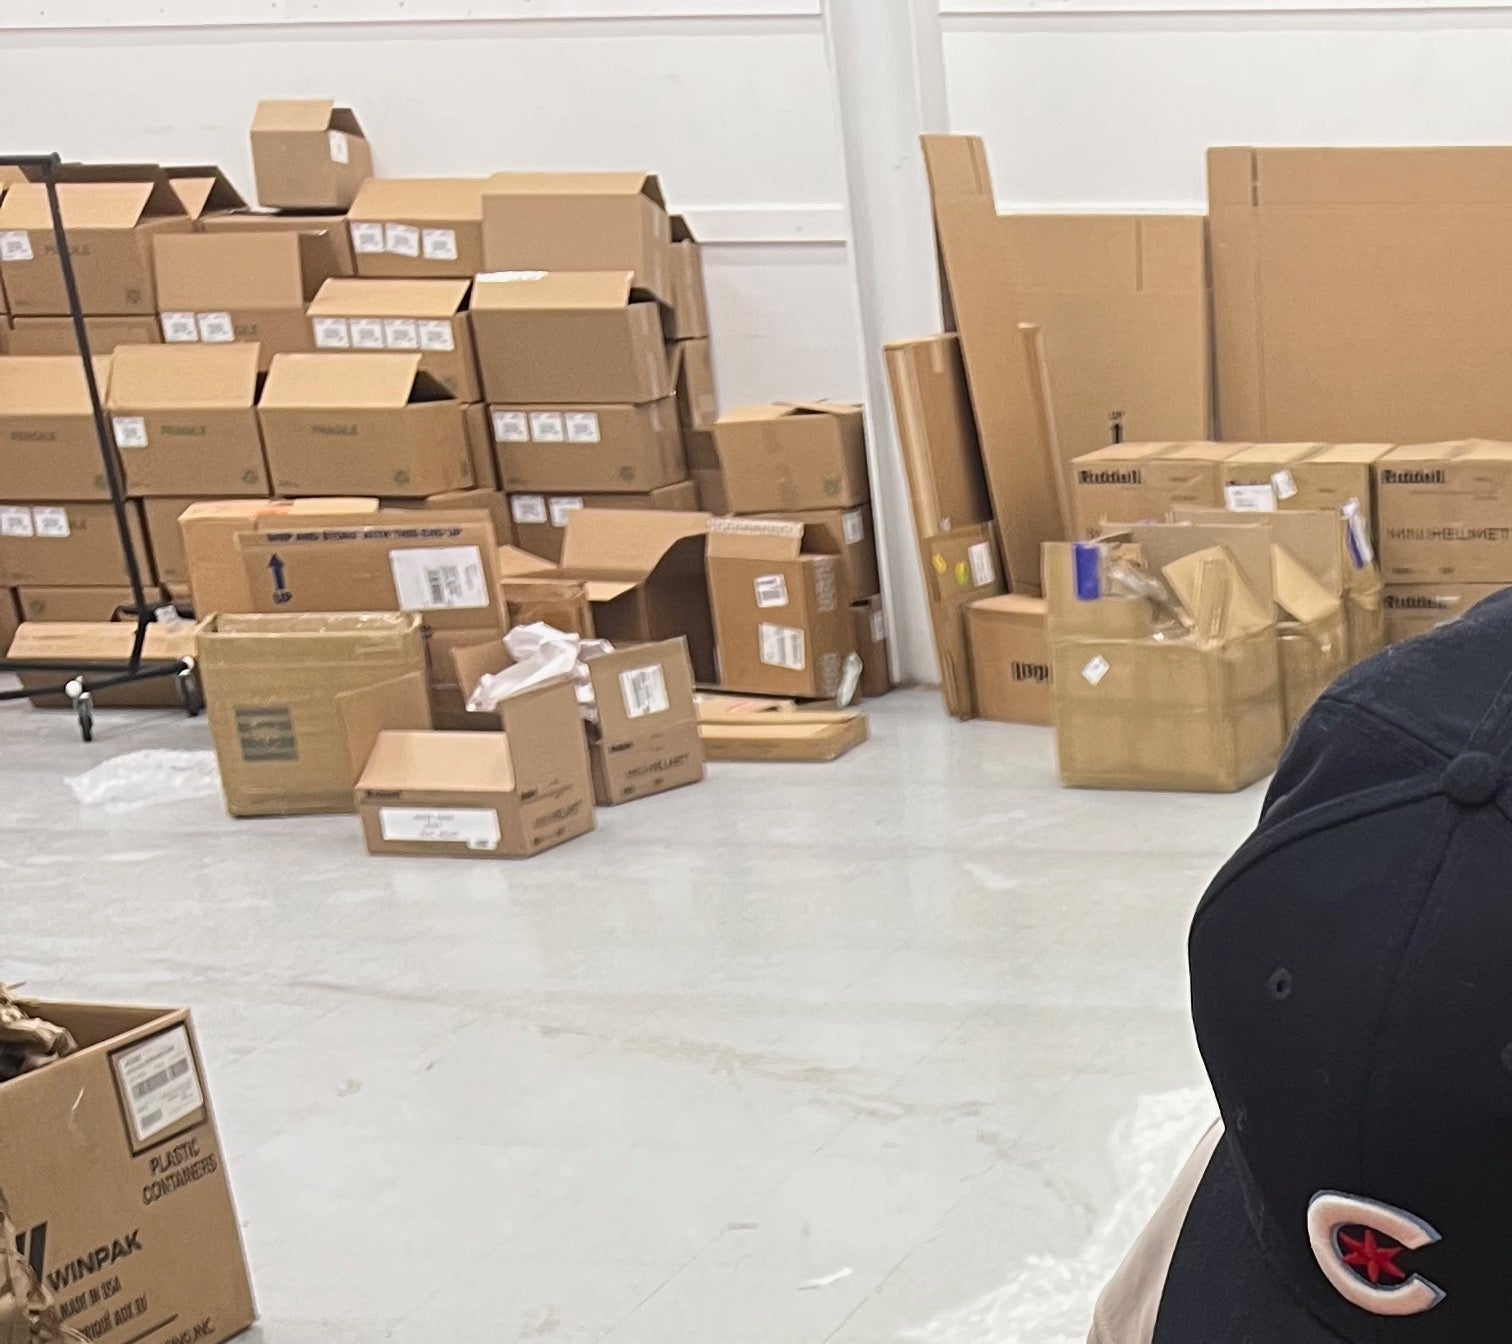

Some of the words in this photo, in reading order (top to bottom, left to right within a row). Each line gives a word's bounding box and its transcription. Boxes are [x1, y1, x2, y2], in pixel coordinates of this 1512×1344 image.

[142, 1153, 218, 1206] CONTAINERS
[149, 1136, 200, 1175] PLASTIC
[48, 1230, 142, 1290] WINPAK
